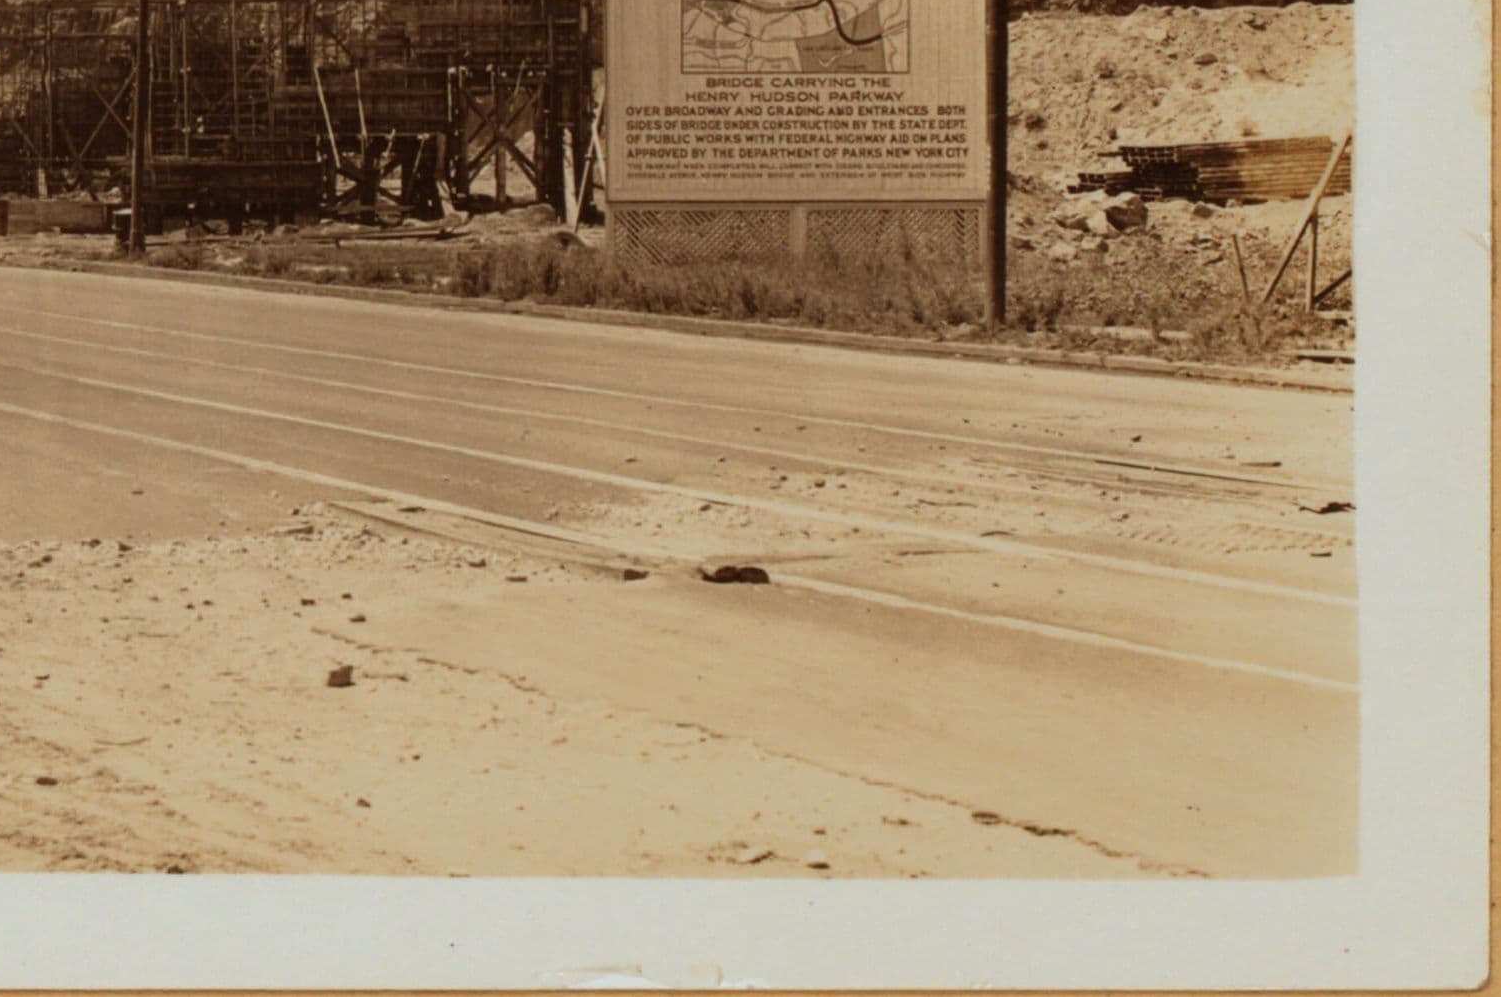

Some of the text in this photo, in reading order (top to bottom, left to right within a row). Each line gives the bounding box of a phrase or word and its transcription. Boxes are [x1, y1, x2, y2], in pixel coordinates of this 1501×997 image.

[706, 76, 892, 89] BRIDGE CARRYING THE
[686, 90, 905, 103] HENRY HUDSON PARKWAY
[626, 104, 967, 117] OVER BROADWAY AND GRADING AND ENTRANCES BOTH
[626, 118, 663, 131] SIDES
[664, 118, 679, 131] OF
[680, 118, 722, 131] BRIDGE
[723, 118, 761, 131] UNDER
[762, 118, 850, 131] CONSTRUCTION
[852, 118, 869, 131] BY
[871, 118, 896, 131] THE
[899, 118, 936, 131] STATE
[626, 132, 967, 145] OF PUBLIC WORKS WITH FEDERAL HIGHWAY AID ON PLANS
[626, 146, 970, 159] APPROVED BY THE DEPARTMENT OF PARKS NEW YORK CITY
